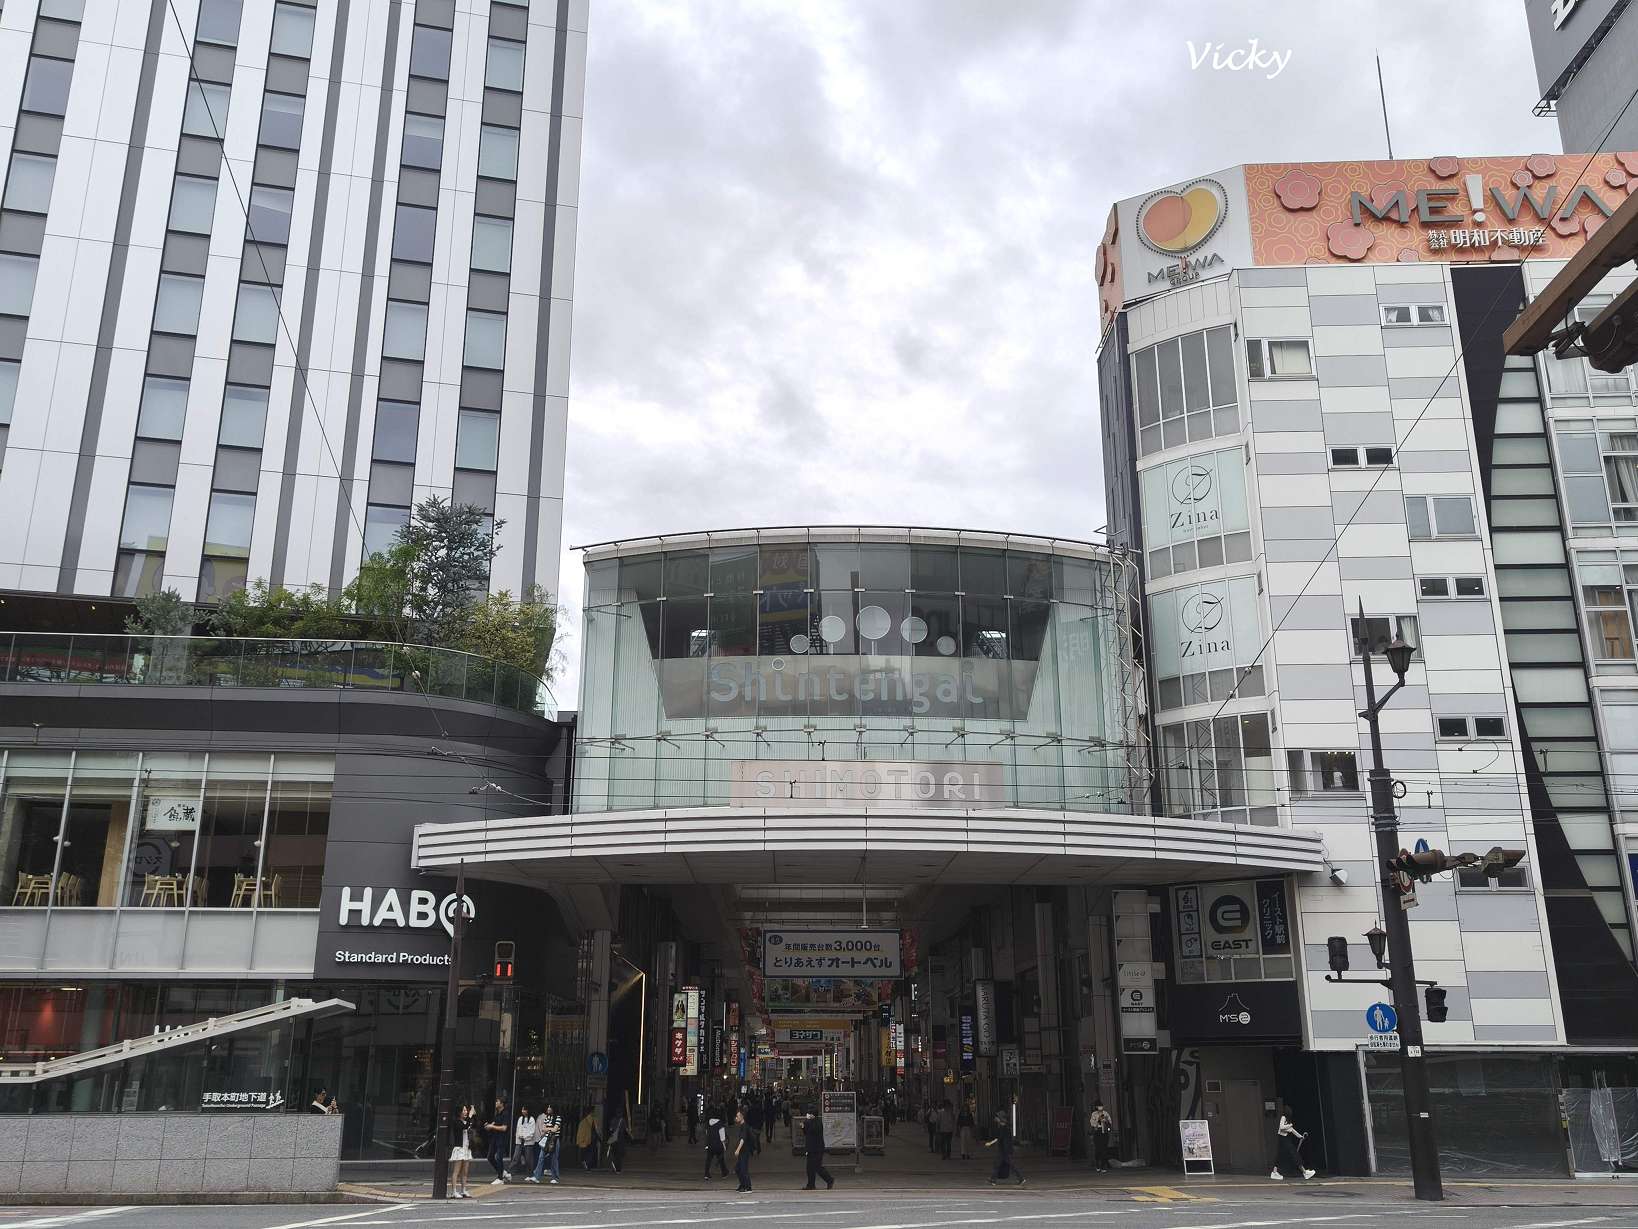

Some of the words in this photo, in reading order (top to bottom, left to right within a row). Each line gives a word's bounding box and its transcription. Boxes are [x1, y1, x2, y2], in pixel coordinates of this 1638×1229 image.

[1450, 228, 1547, 248] 明和不動産
[1170, 508, 1219, 528] Zina
[1180, 639, 1231, 658] Zina
[709, 655, 984, 714] Shintengai
[756, 768, 981, 800] SHIMOTORI
[1211, 939, 1253, 950] EAST
[335, 950, 397, 963] Standard
[773, 956, 892, 969] とりあえずオートベル
[202, 1092, 267, 1103] 手取本町地下道
